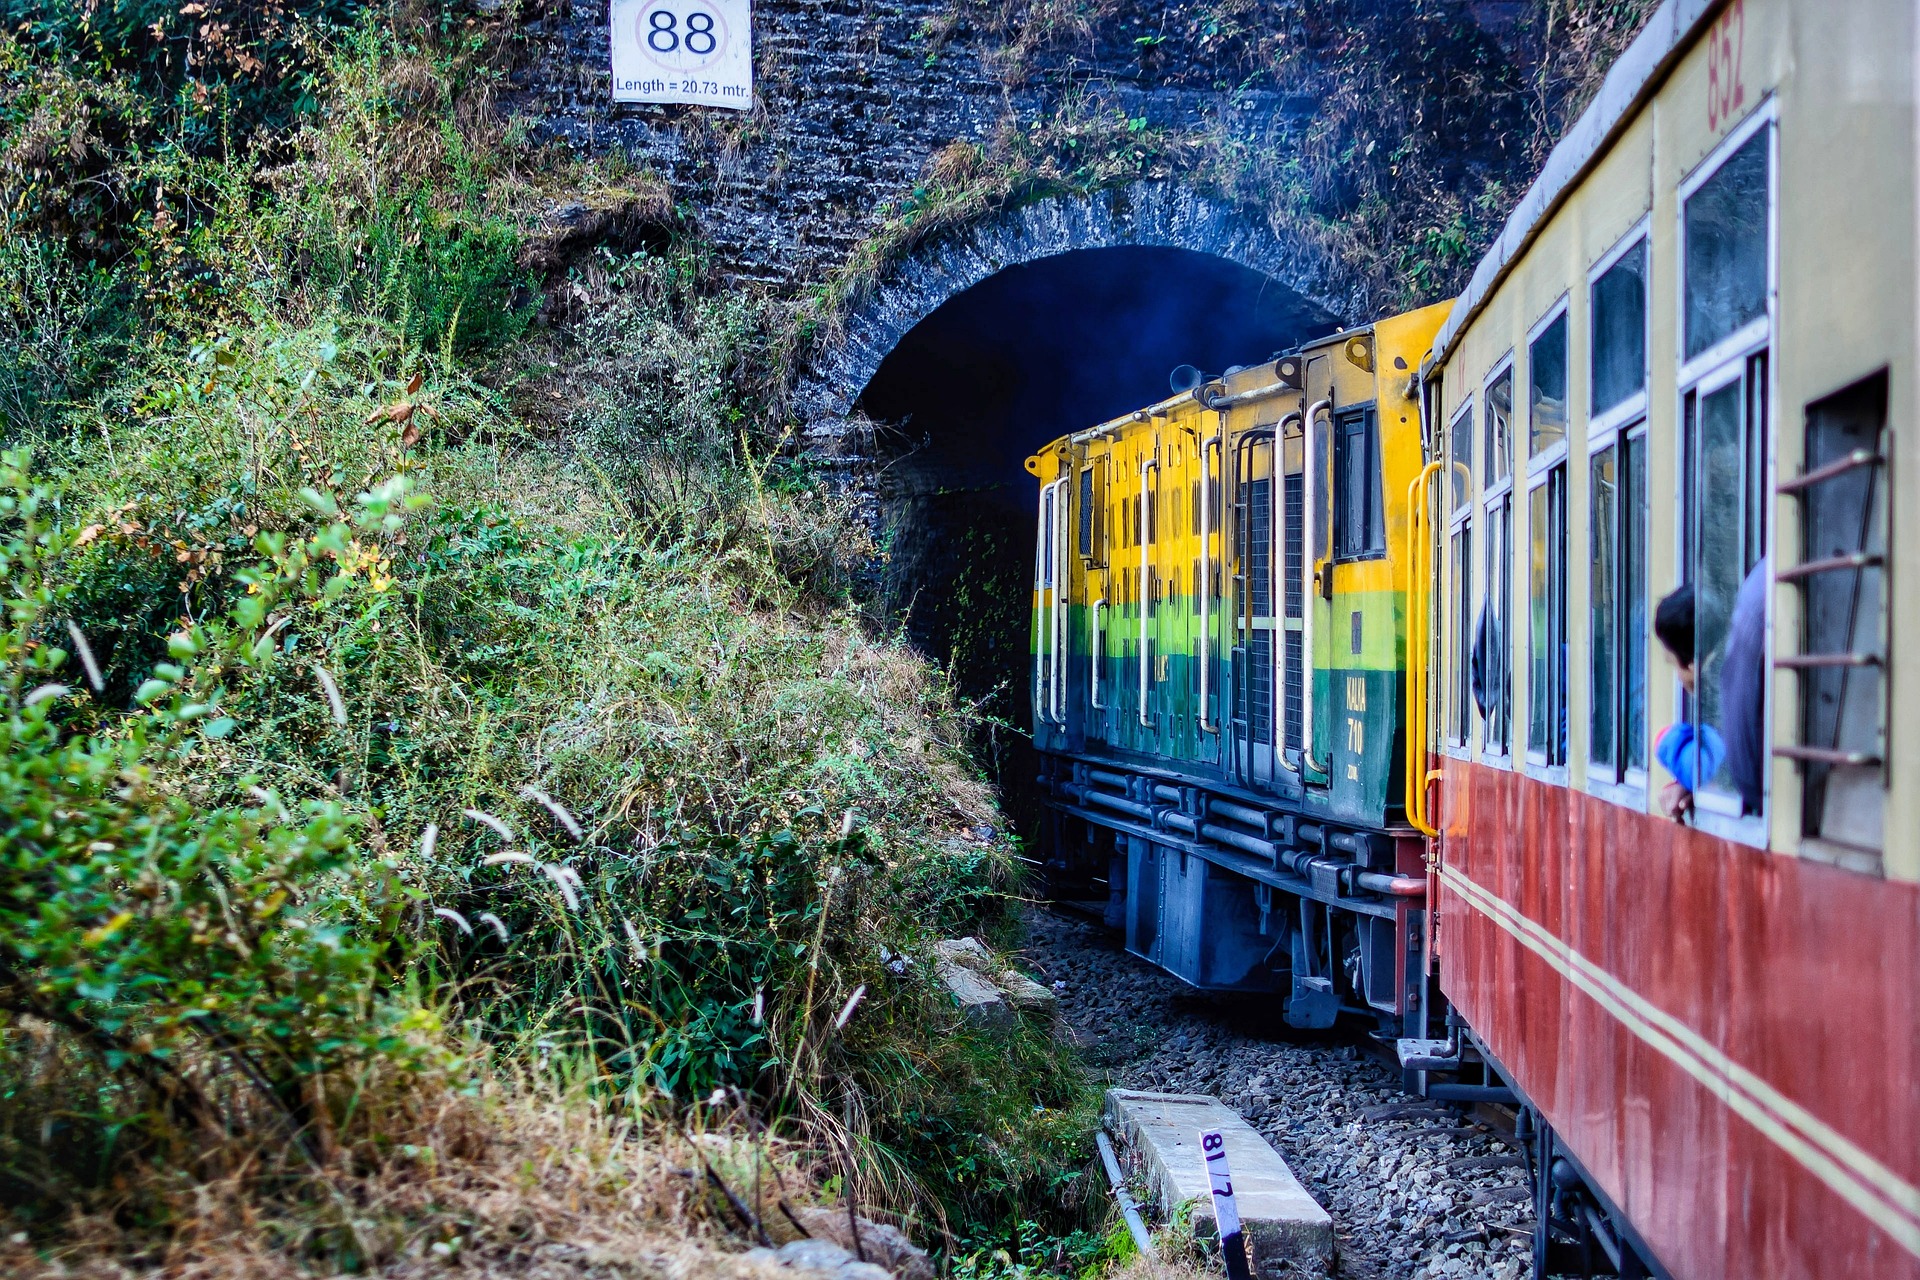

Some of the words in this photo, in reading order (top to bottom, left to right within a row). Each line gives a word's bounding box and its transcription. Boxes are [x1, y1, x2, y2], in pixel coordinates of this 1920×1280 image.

[648, 10, 717, 55] 88
[1708, 0, 1744, 132] 852
[616, 78, 665, 94] Length
[669, 82, 678, 90] =
[682, 80, 718, 95] 20.73
[723, 84, 749, 98] mtr.
[1346, 676, 1366, 712] KALKA
[1347, 717, 1363, 756] 710
